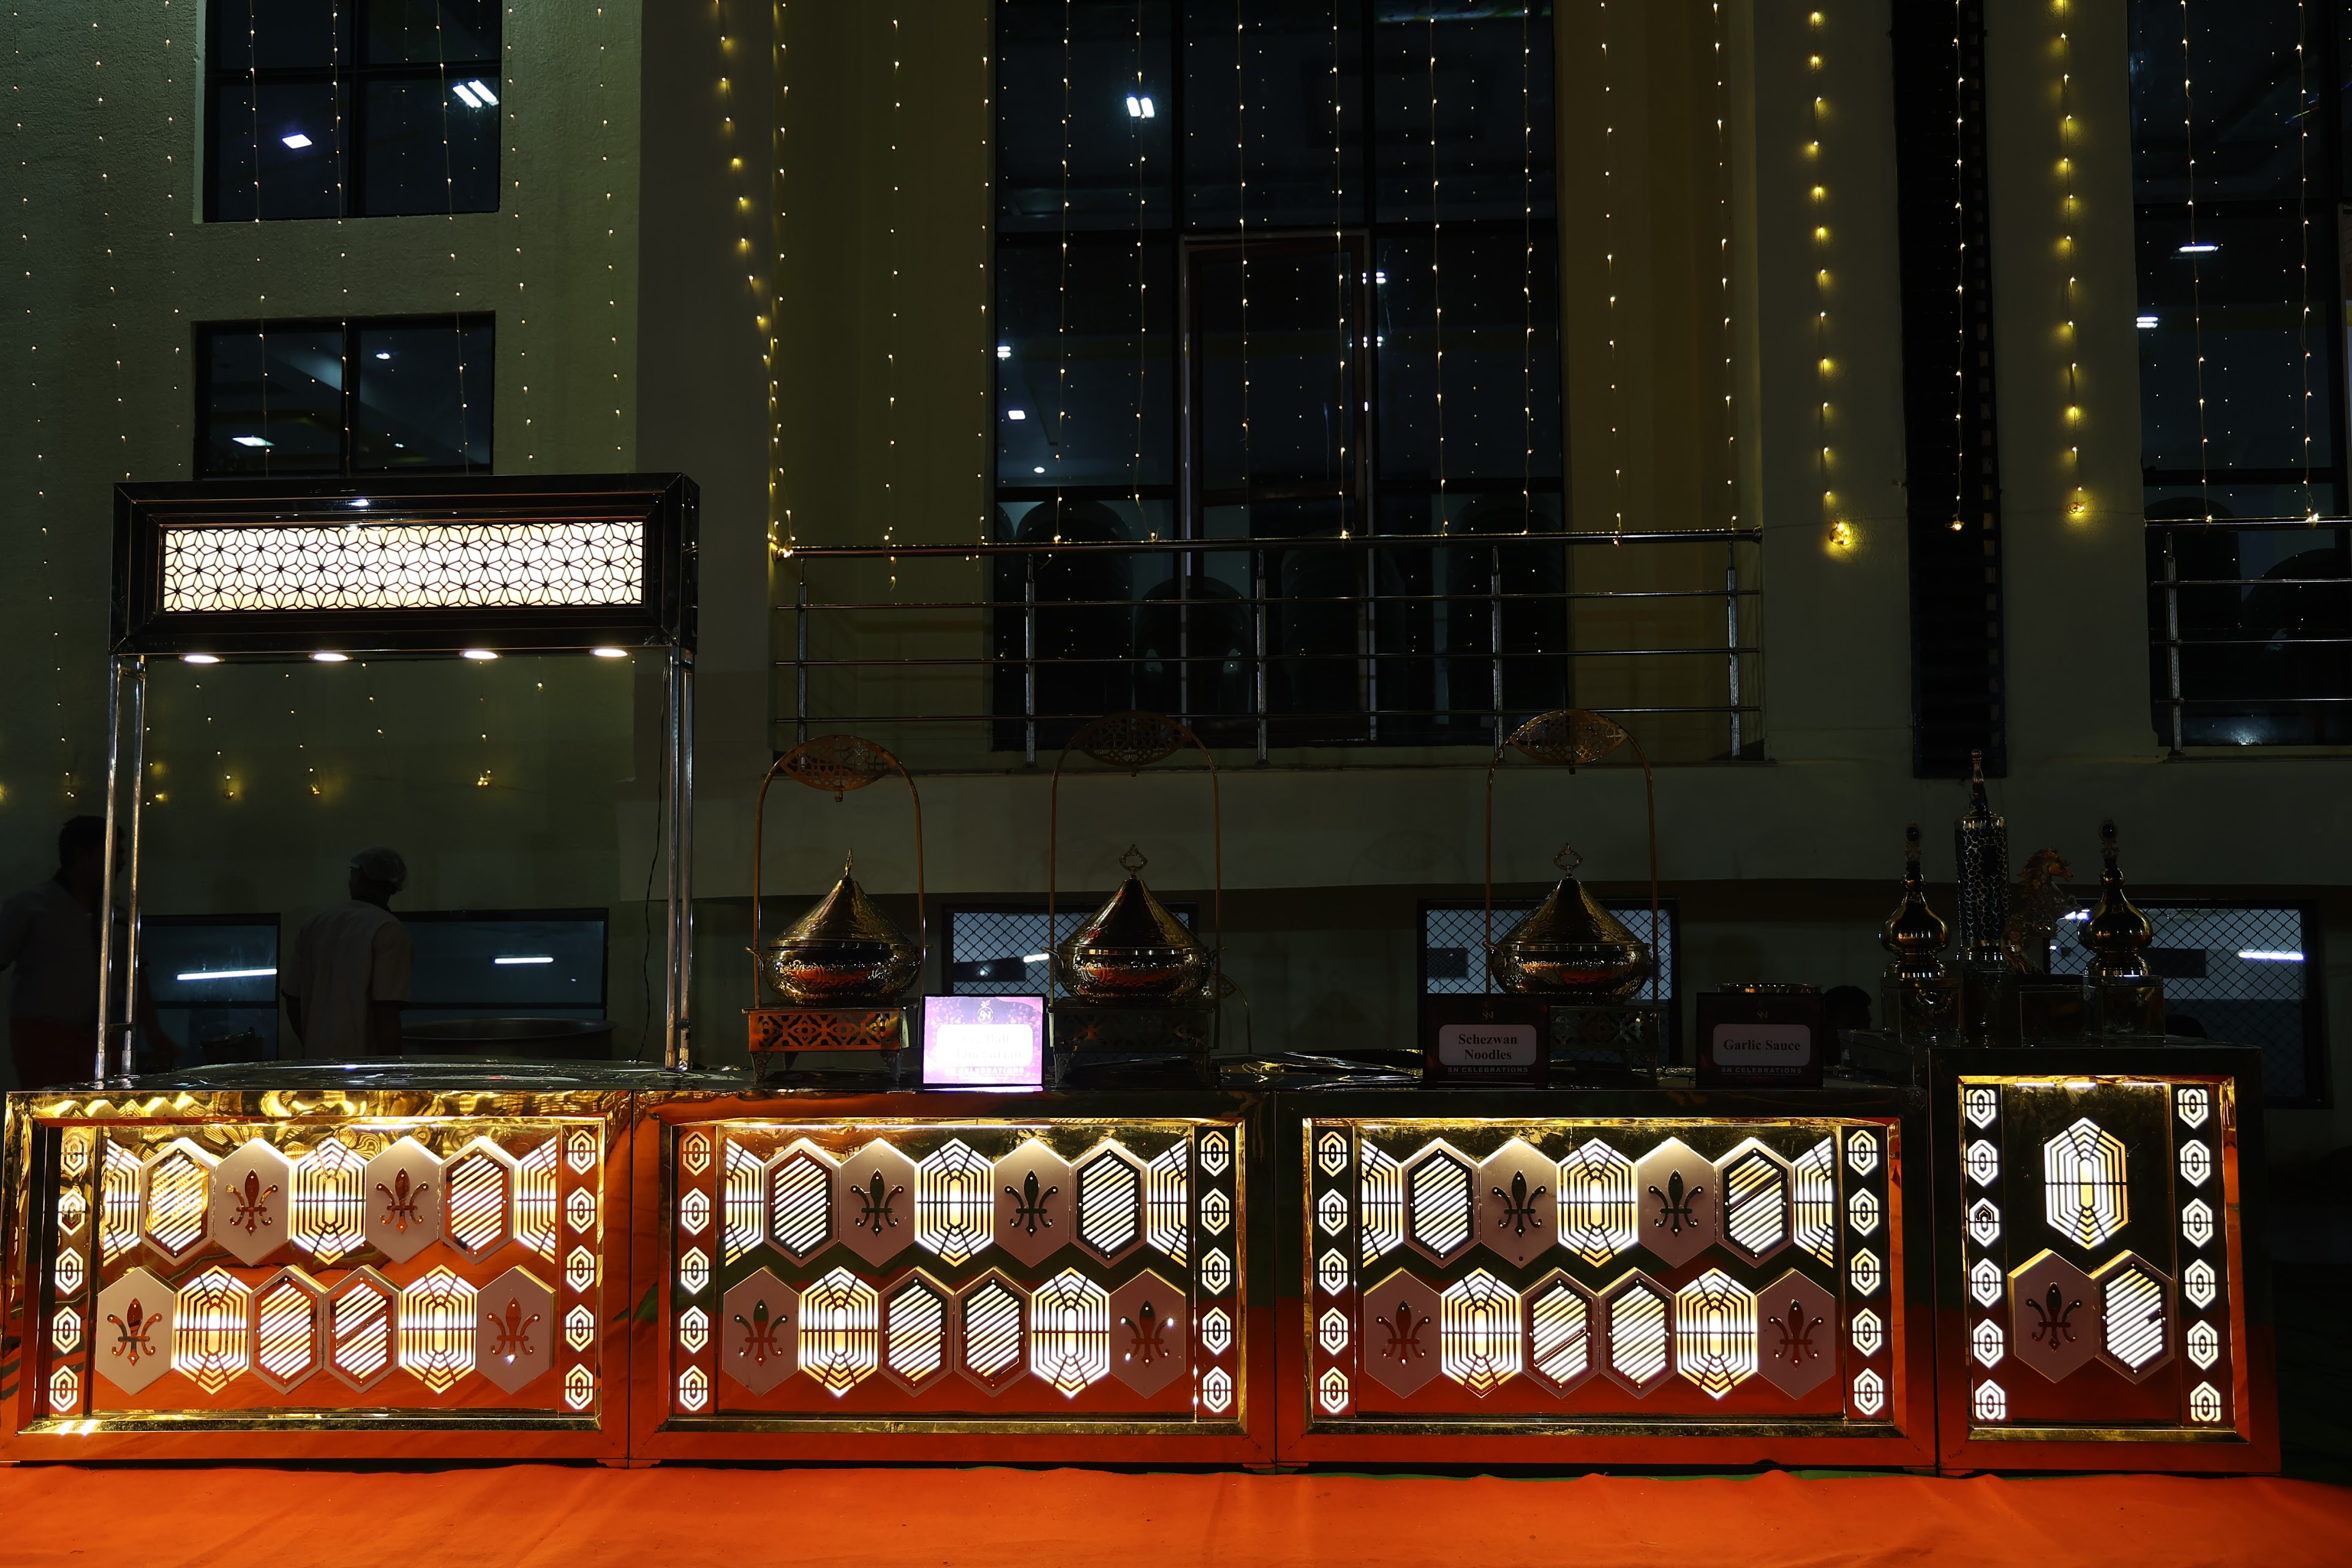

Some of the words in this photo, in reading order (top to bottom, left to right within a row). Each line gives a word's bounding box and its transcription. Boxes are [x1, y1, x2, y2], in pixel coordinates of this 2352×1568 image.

[1458, 1034, 1517, 1044] Schezwan
[1724, 1039, 1762, 1050] Garlic
[1765, 1039, 1800, 1050] Sauce
[1464, 1049, 1512, 1060] Noodles
